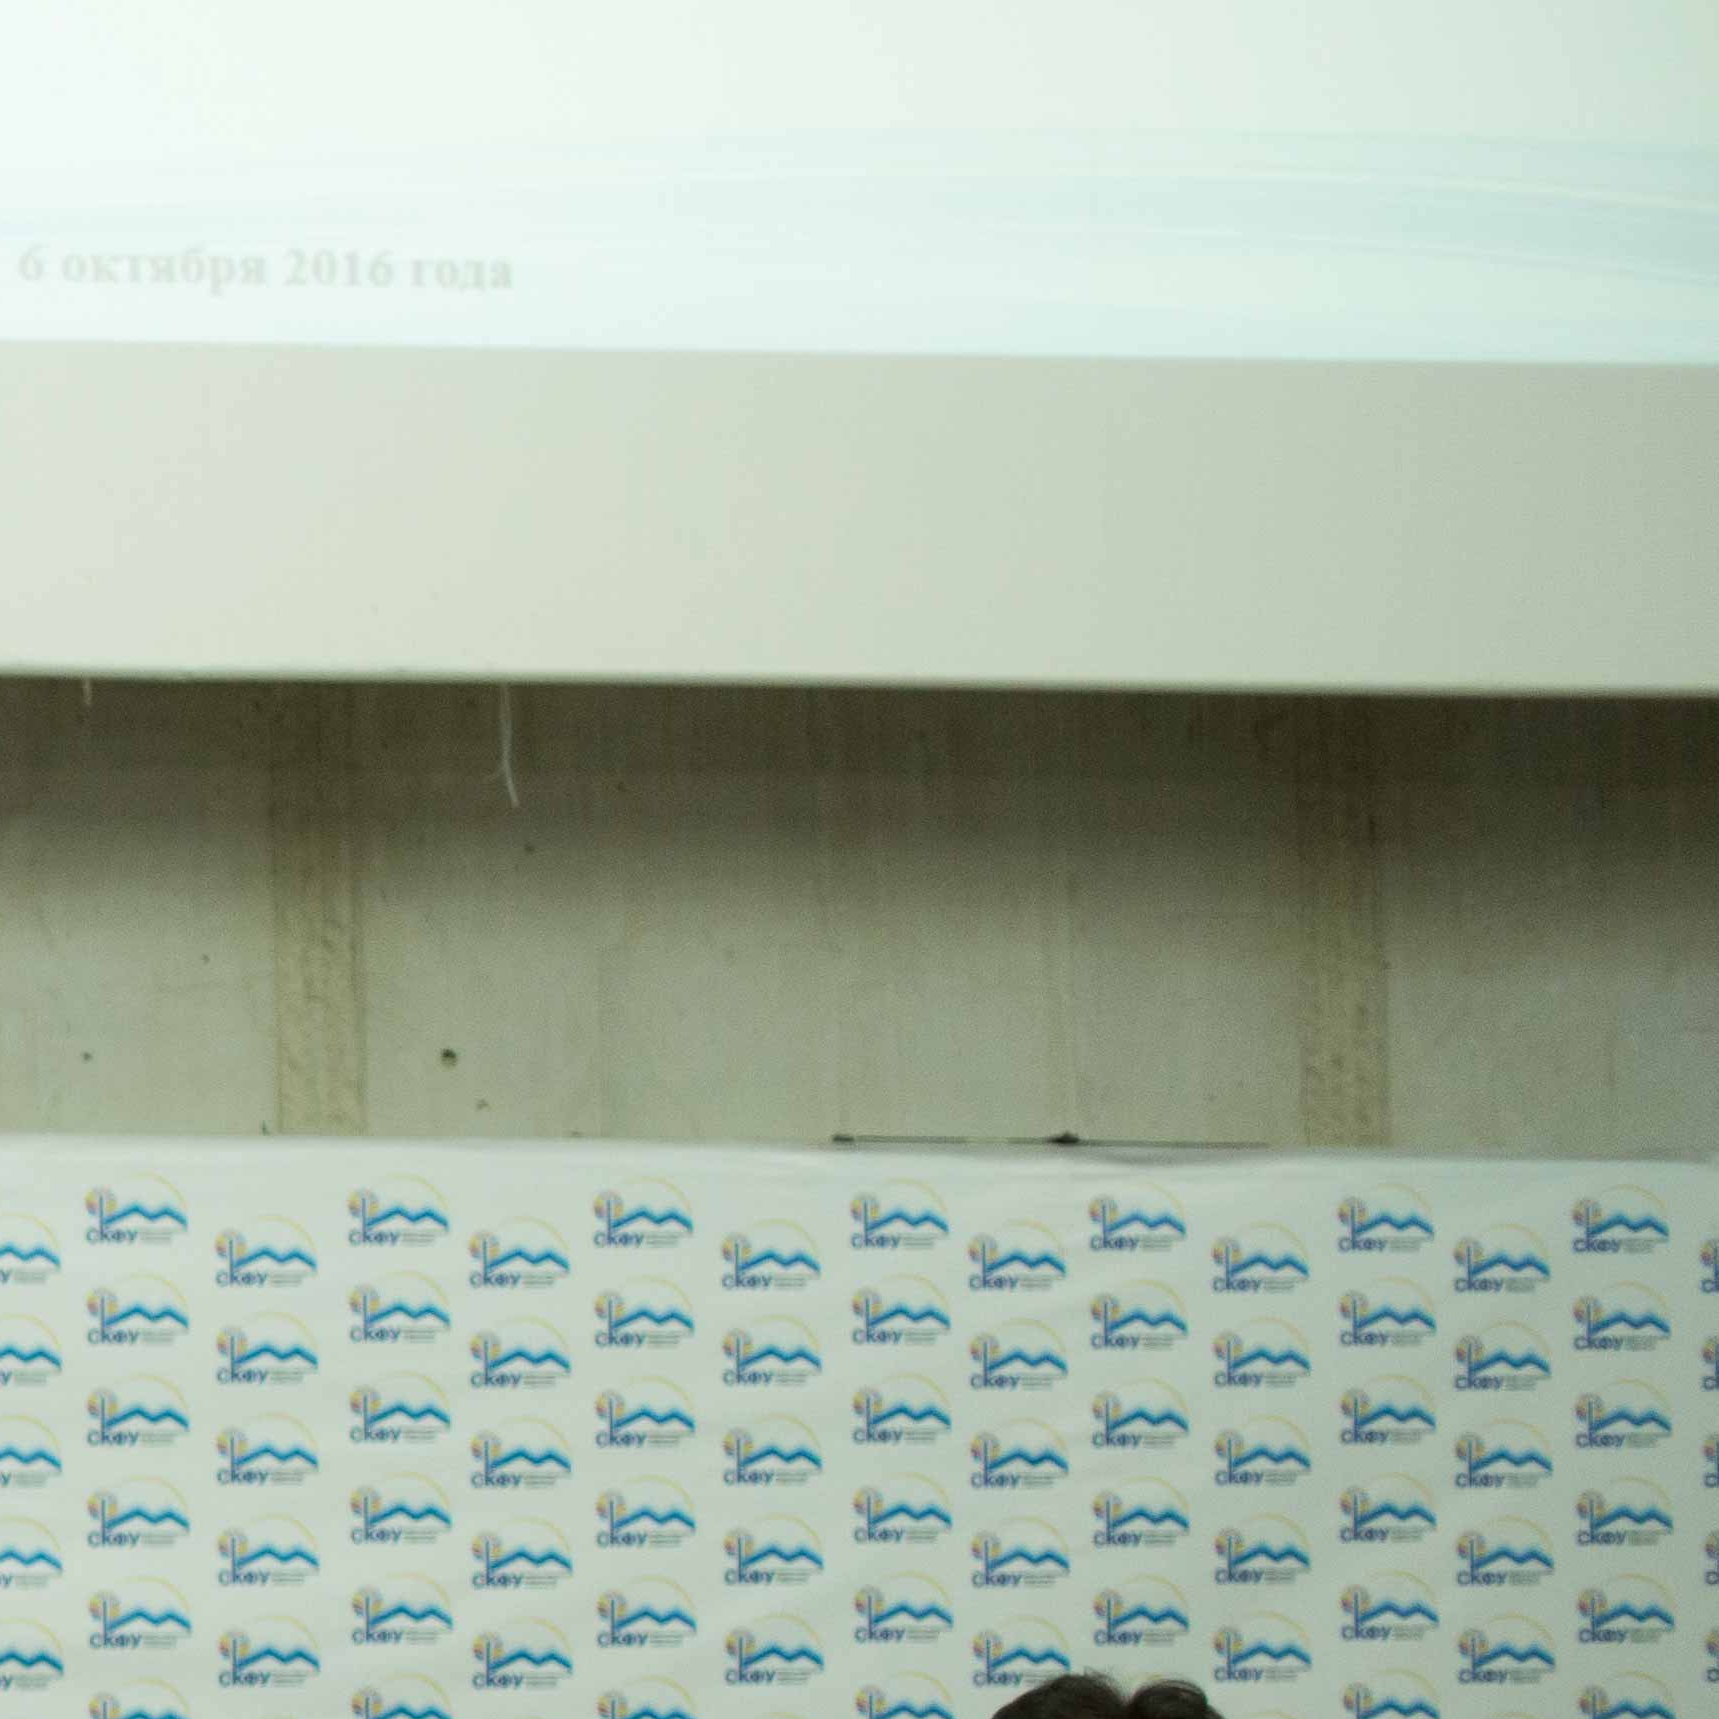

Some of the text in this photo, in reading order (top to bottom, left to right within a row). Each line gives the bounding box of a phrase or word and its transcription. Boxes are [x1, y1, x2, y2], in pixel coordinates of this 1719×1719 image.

[18, 242, 514, 297] 6 октября 2016 года
